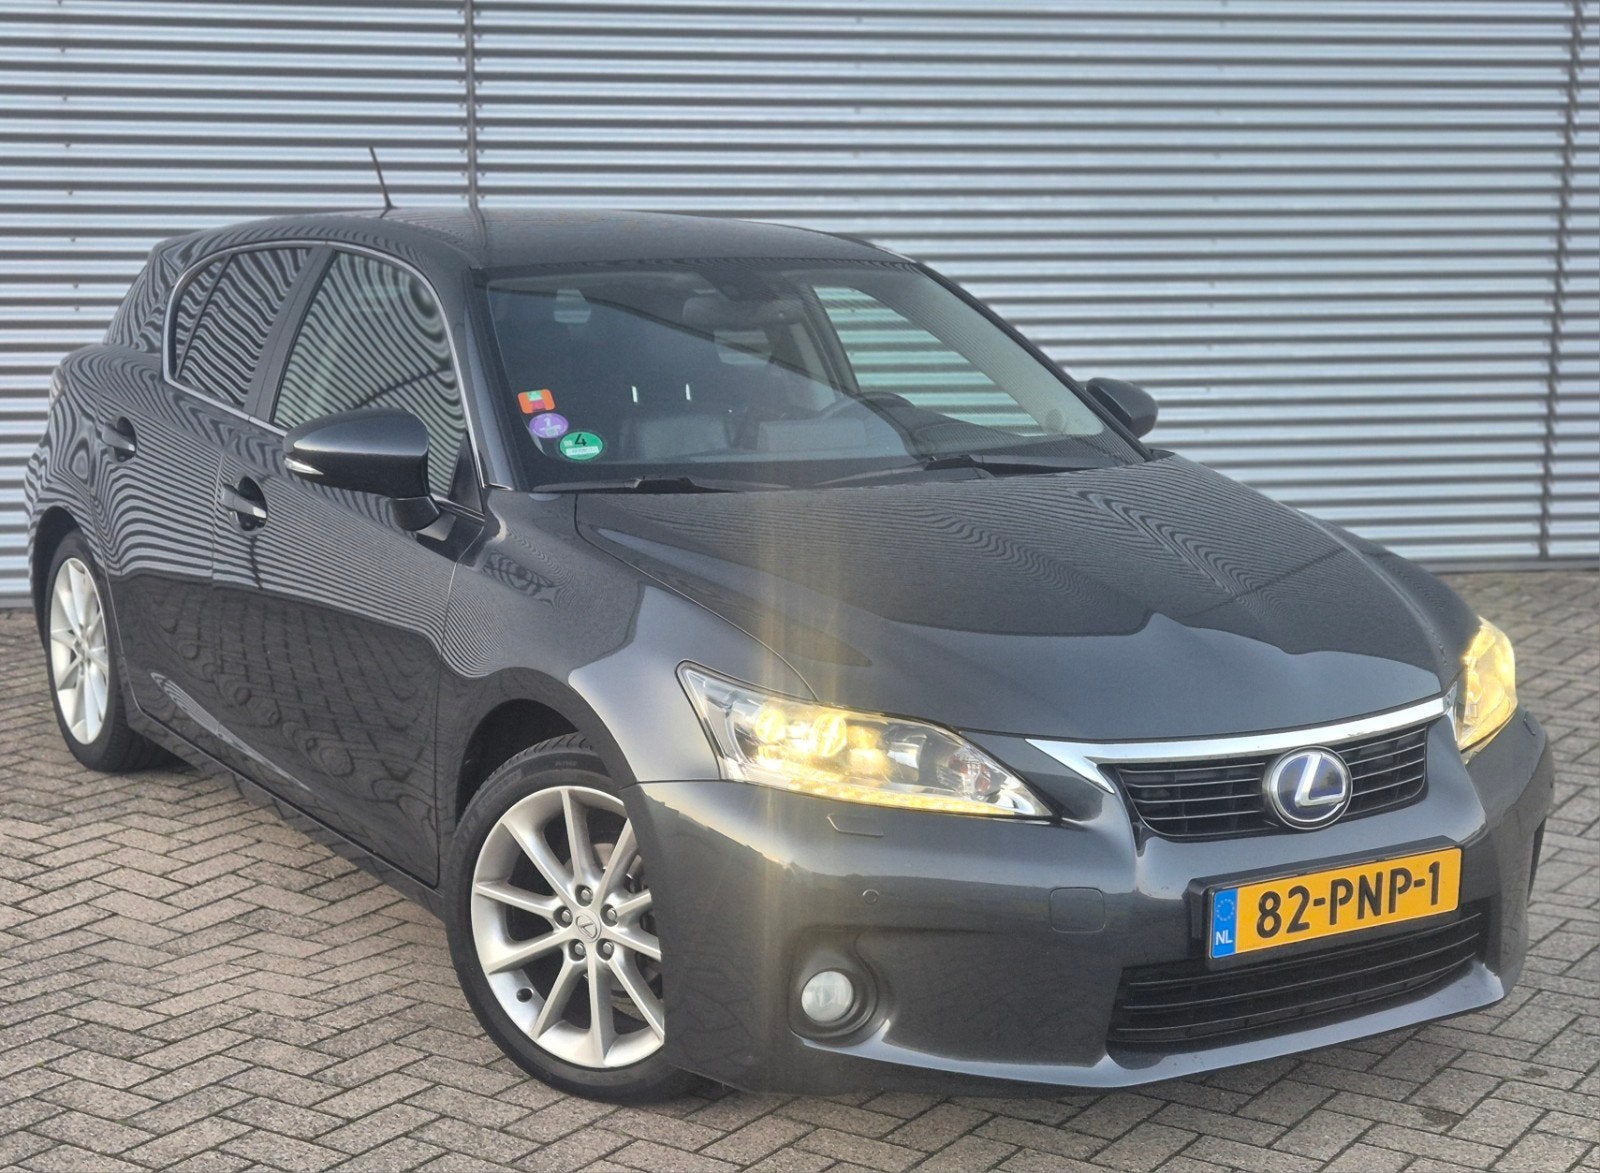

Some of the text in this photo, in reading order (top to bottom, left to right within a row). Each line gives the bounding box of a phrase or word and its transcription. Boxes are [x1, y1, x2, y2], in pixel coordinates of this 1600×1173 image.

[574, 433, 587, 446] 4
[1256, 861, 1441, 939] 82-PNP-1
[1215, 929, 1233, 946] NL
